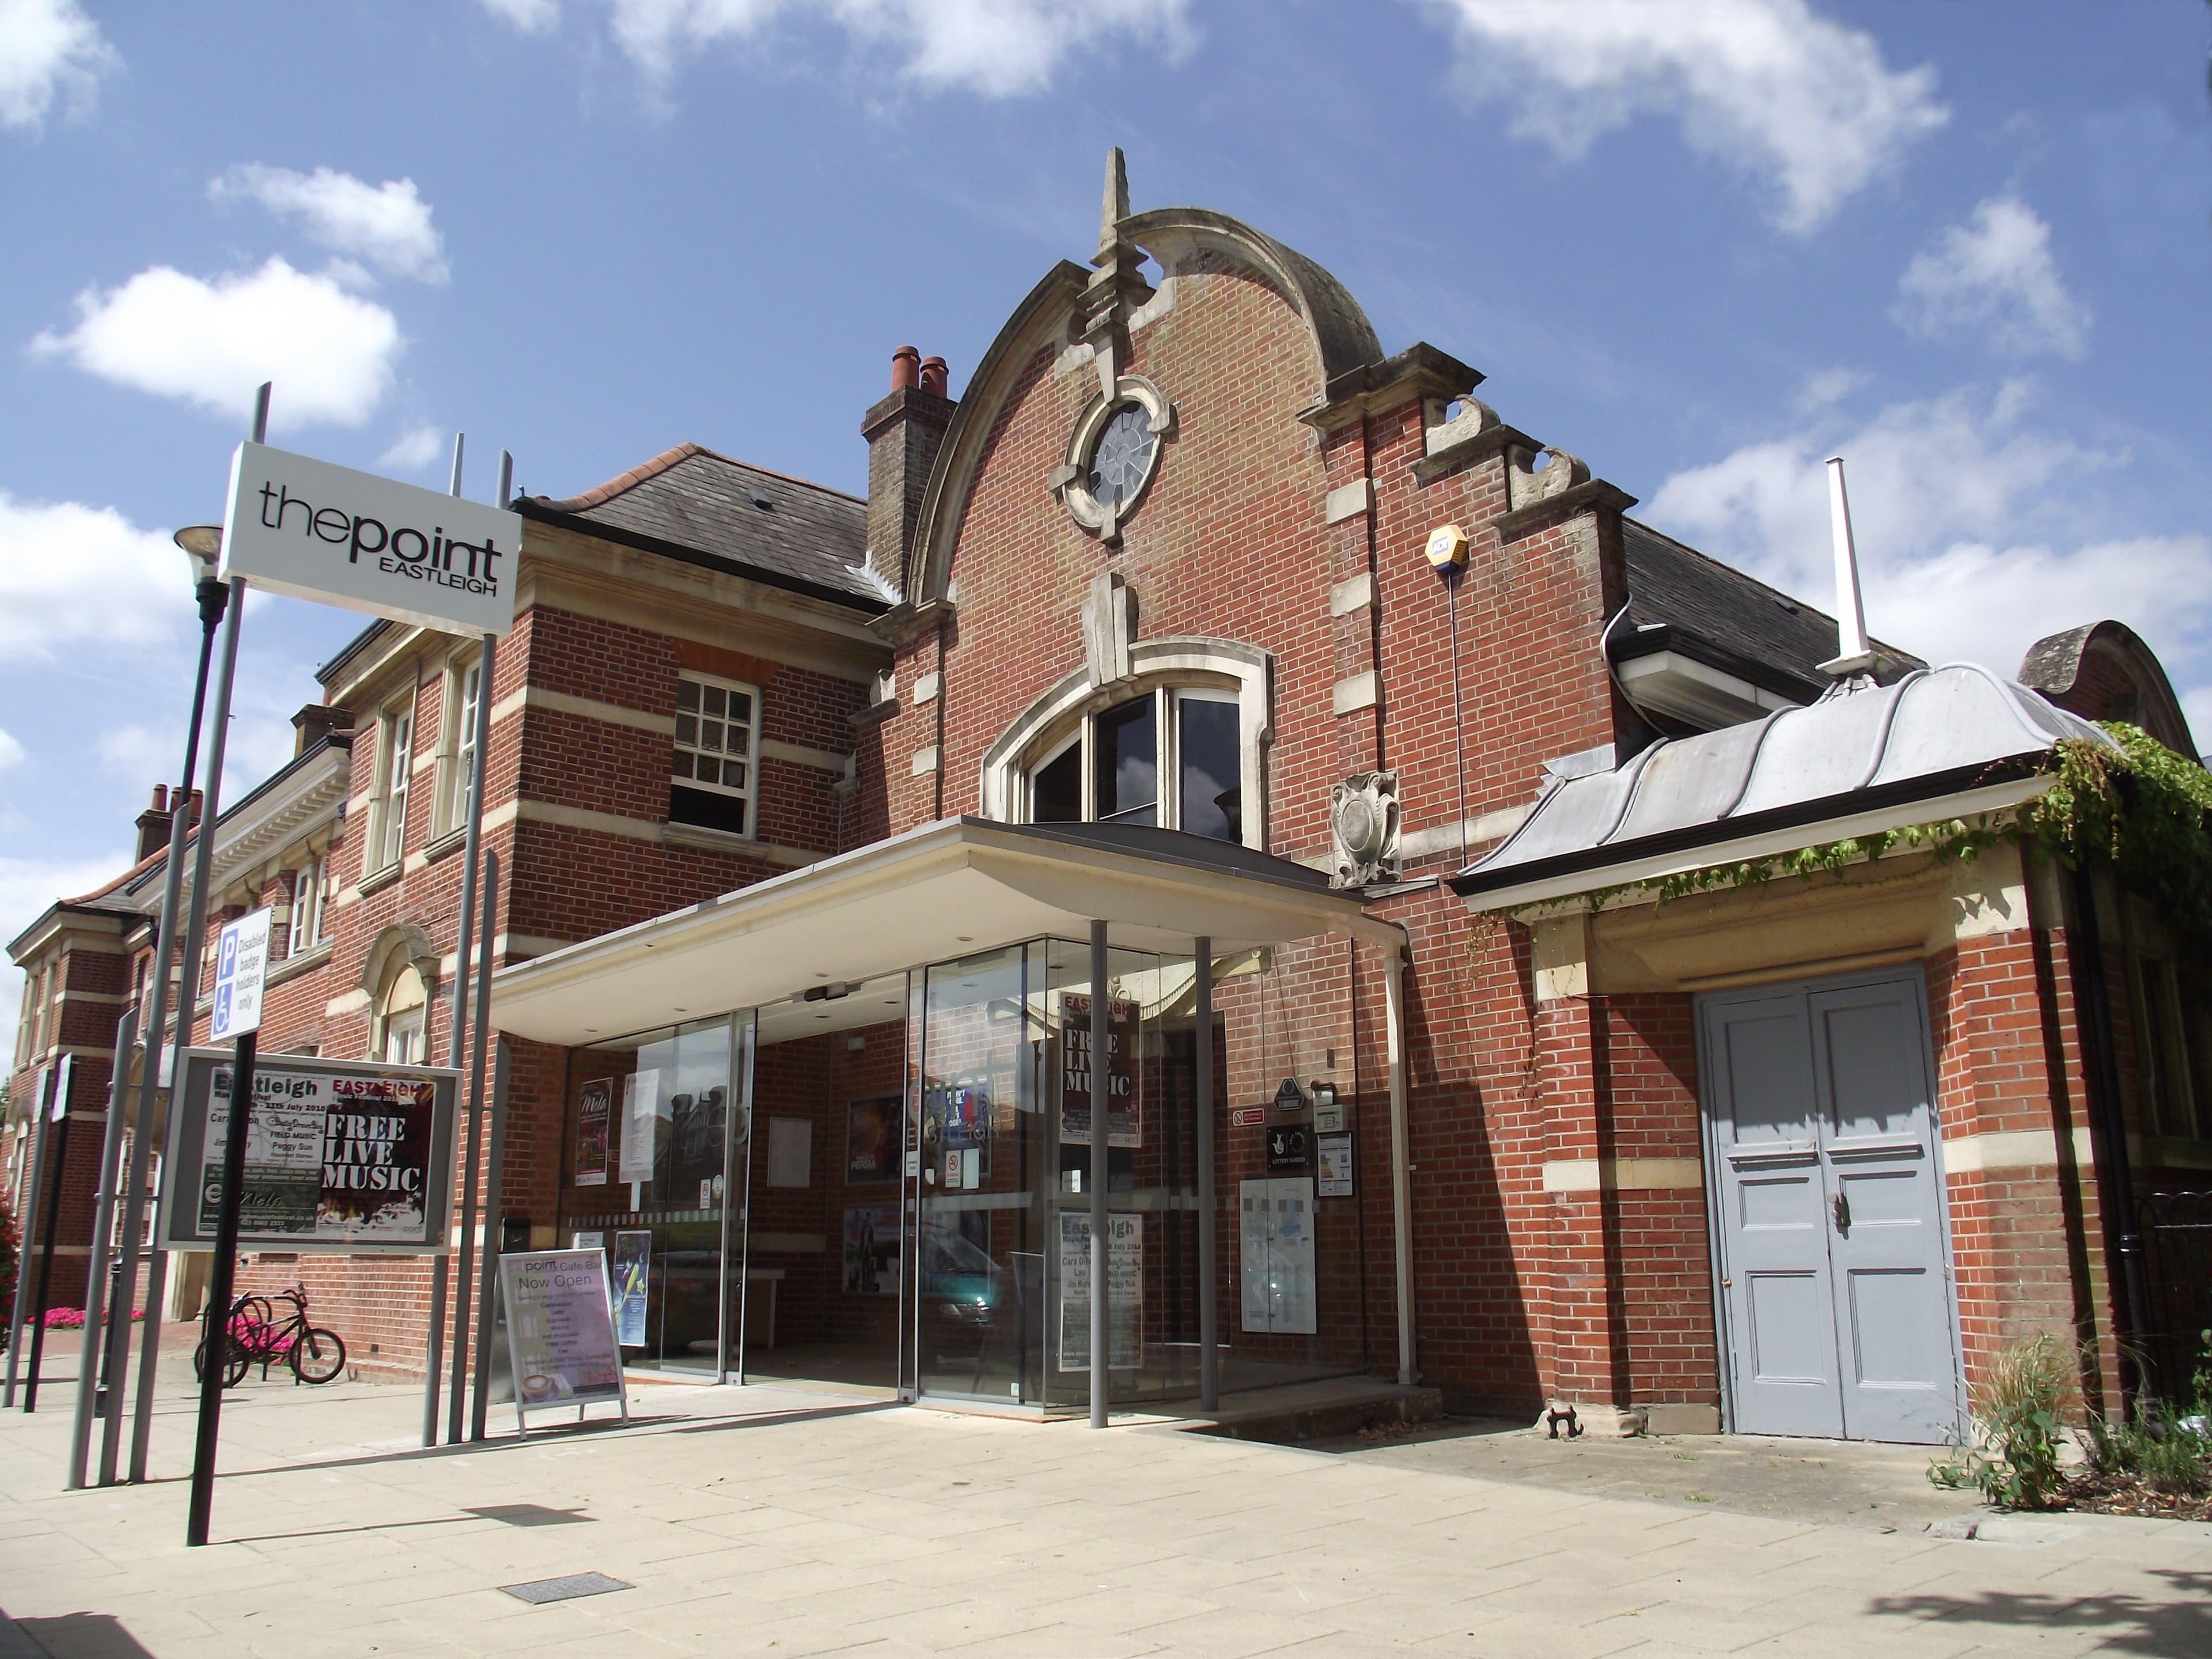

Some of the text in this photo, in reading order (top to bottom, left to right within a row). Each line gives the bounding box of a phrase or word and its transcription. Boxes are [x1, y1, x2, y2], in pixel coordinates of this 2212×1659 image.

[379, 556, 497, 597] EASTLEIGH
[238, 930, 267, 953] Disabled
[222, 935, 236, 975] P
[240, 954, 260, 972] badge
[236, 974, 260, 992] holders
[238, 995, 253, 1010] only
[1066, 1029, 1119, 1054] FRE
[1066, 1071, 1130, 1096] MUIC
[286, 1103, 304, 1112] July
[581, 1093, 607, 1113] Mela
[325, 1113, 406, 1141] FREE
[272, 1142, 297, 1151] Peggy
[323, 1139, 394, 1165] LIVE
[850, 1160, 876, 1171] PERSIA
[321, 1164, 421, 1192] MUSIC
[525, 1259, 557, 1274] point
[585, 1260, 602, 1270] Bar
[1062, 1257, 1077, 1266] Cara
[519, 1274, 592, 1289] Now Open
